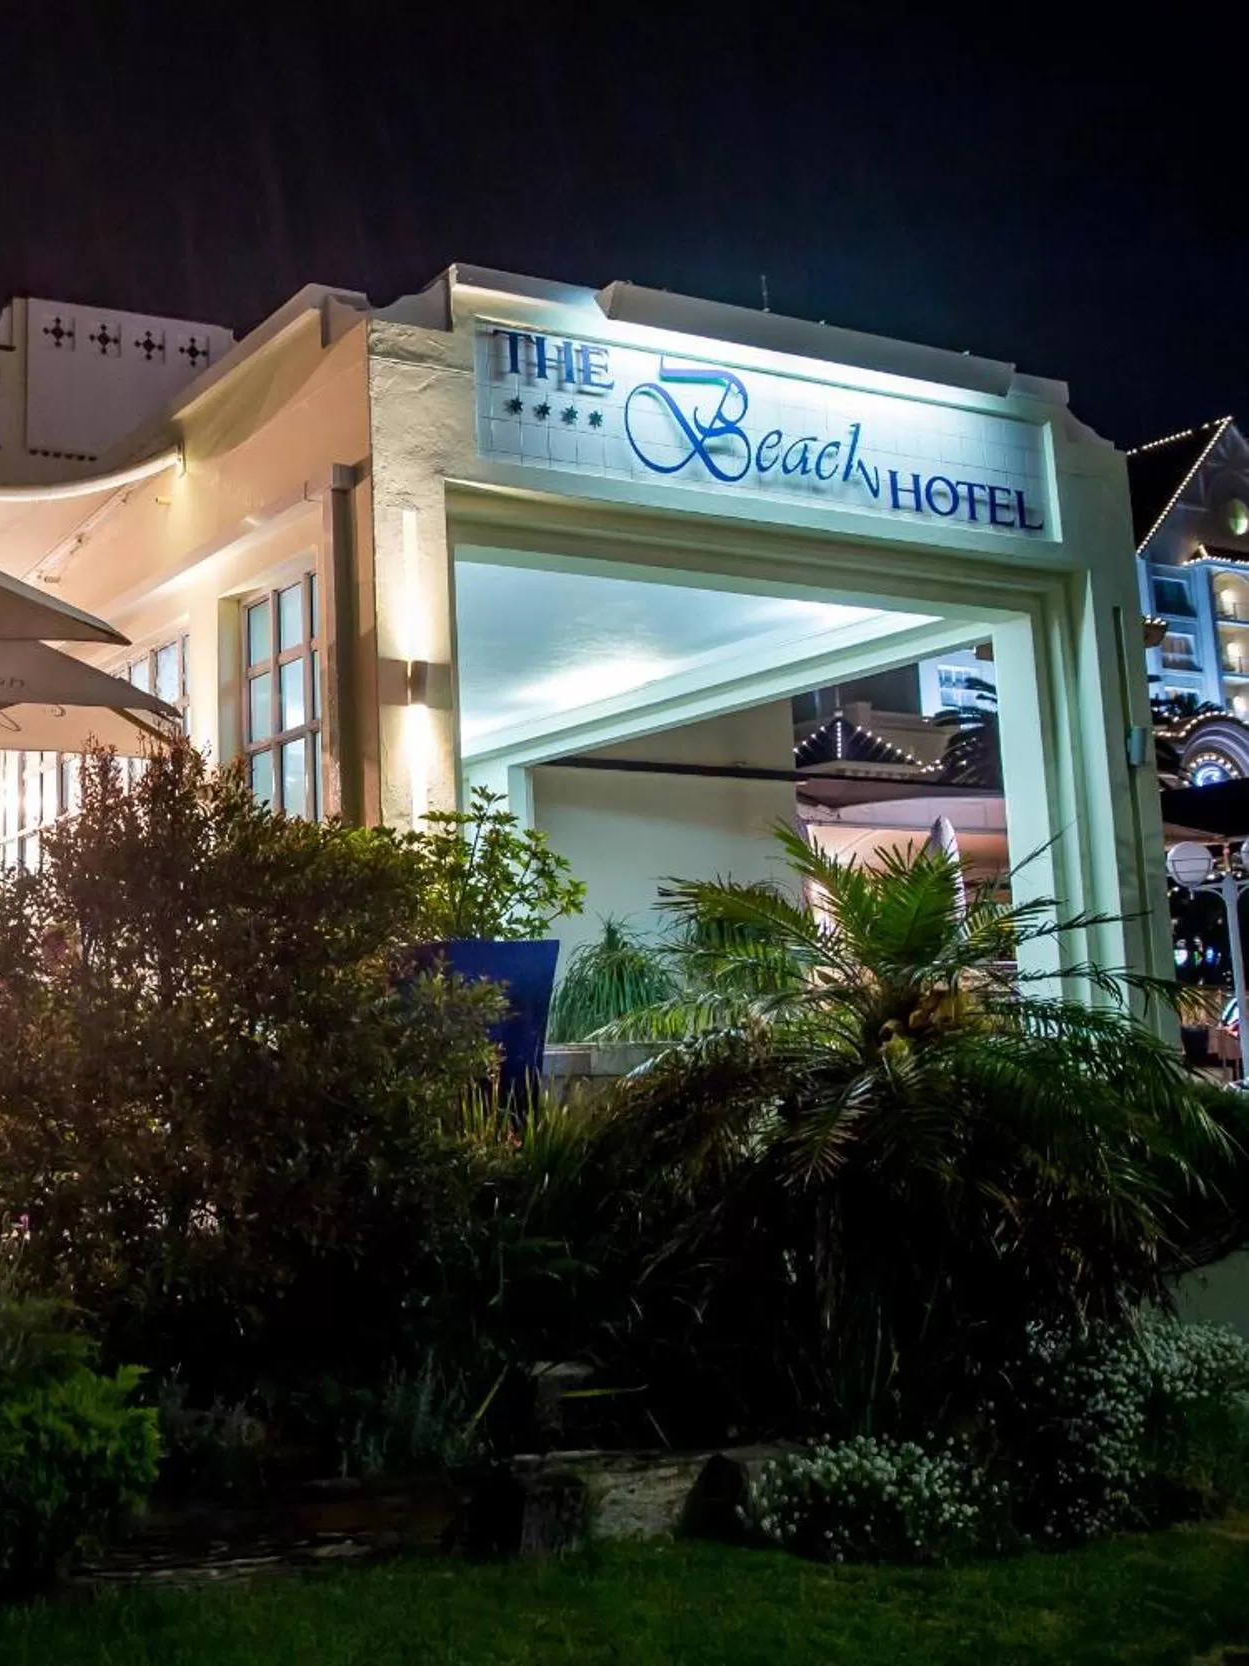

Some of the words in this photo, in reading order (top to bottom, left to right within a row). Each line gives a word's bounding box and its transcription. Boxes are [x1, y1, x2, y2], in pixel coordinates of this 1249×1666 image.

[492, 328, 614, 391] THE
[624, 354, 880, 498] Beach
[887, 469, 1043, 530] HOTEL
